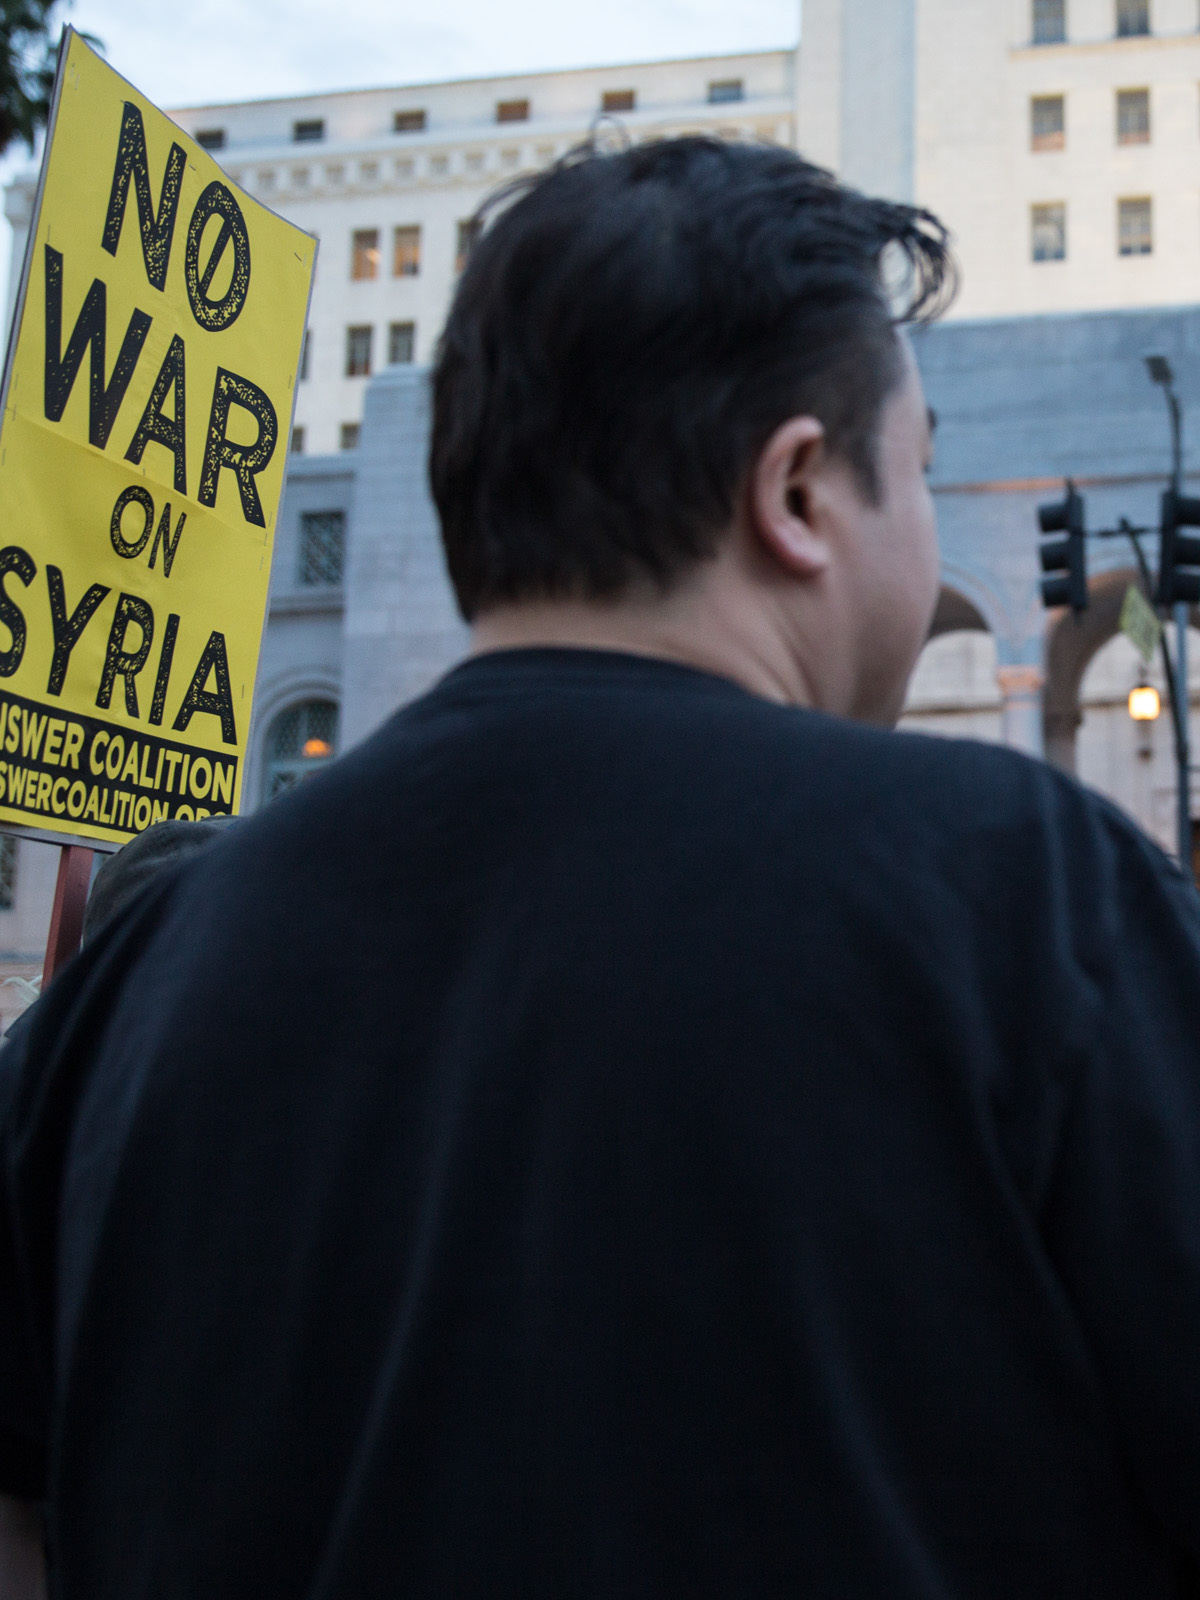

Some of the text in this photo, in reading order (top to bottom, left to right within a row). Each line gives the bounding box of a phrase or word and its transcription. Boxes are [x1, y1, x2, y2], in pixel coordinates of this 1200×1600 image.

[44, 243, 278, 529] WAR
[110, 484, 187, 578] ON
[0, 545, 238, 746] SYRIA
[89, 730, 235, 804] COALITION
